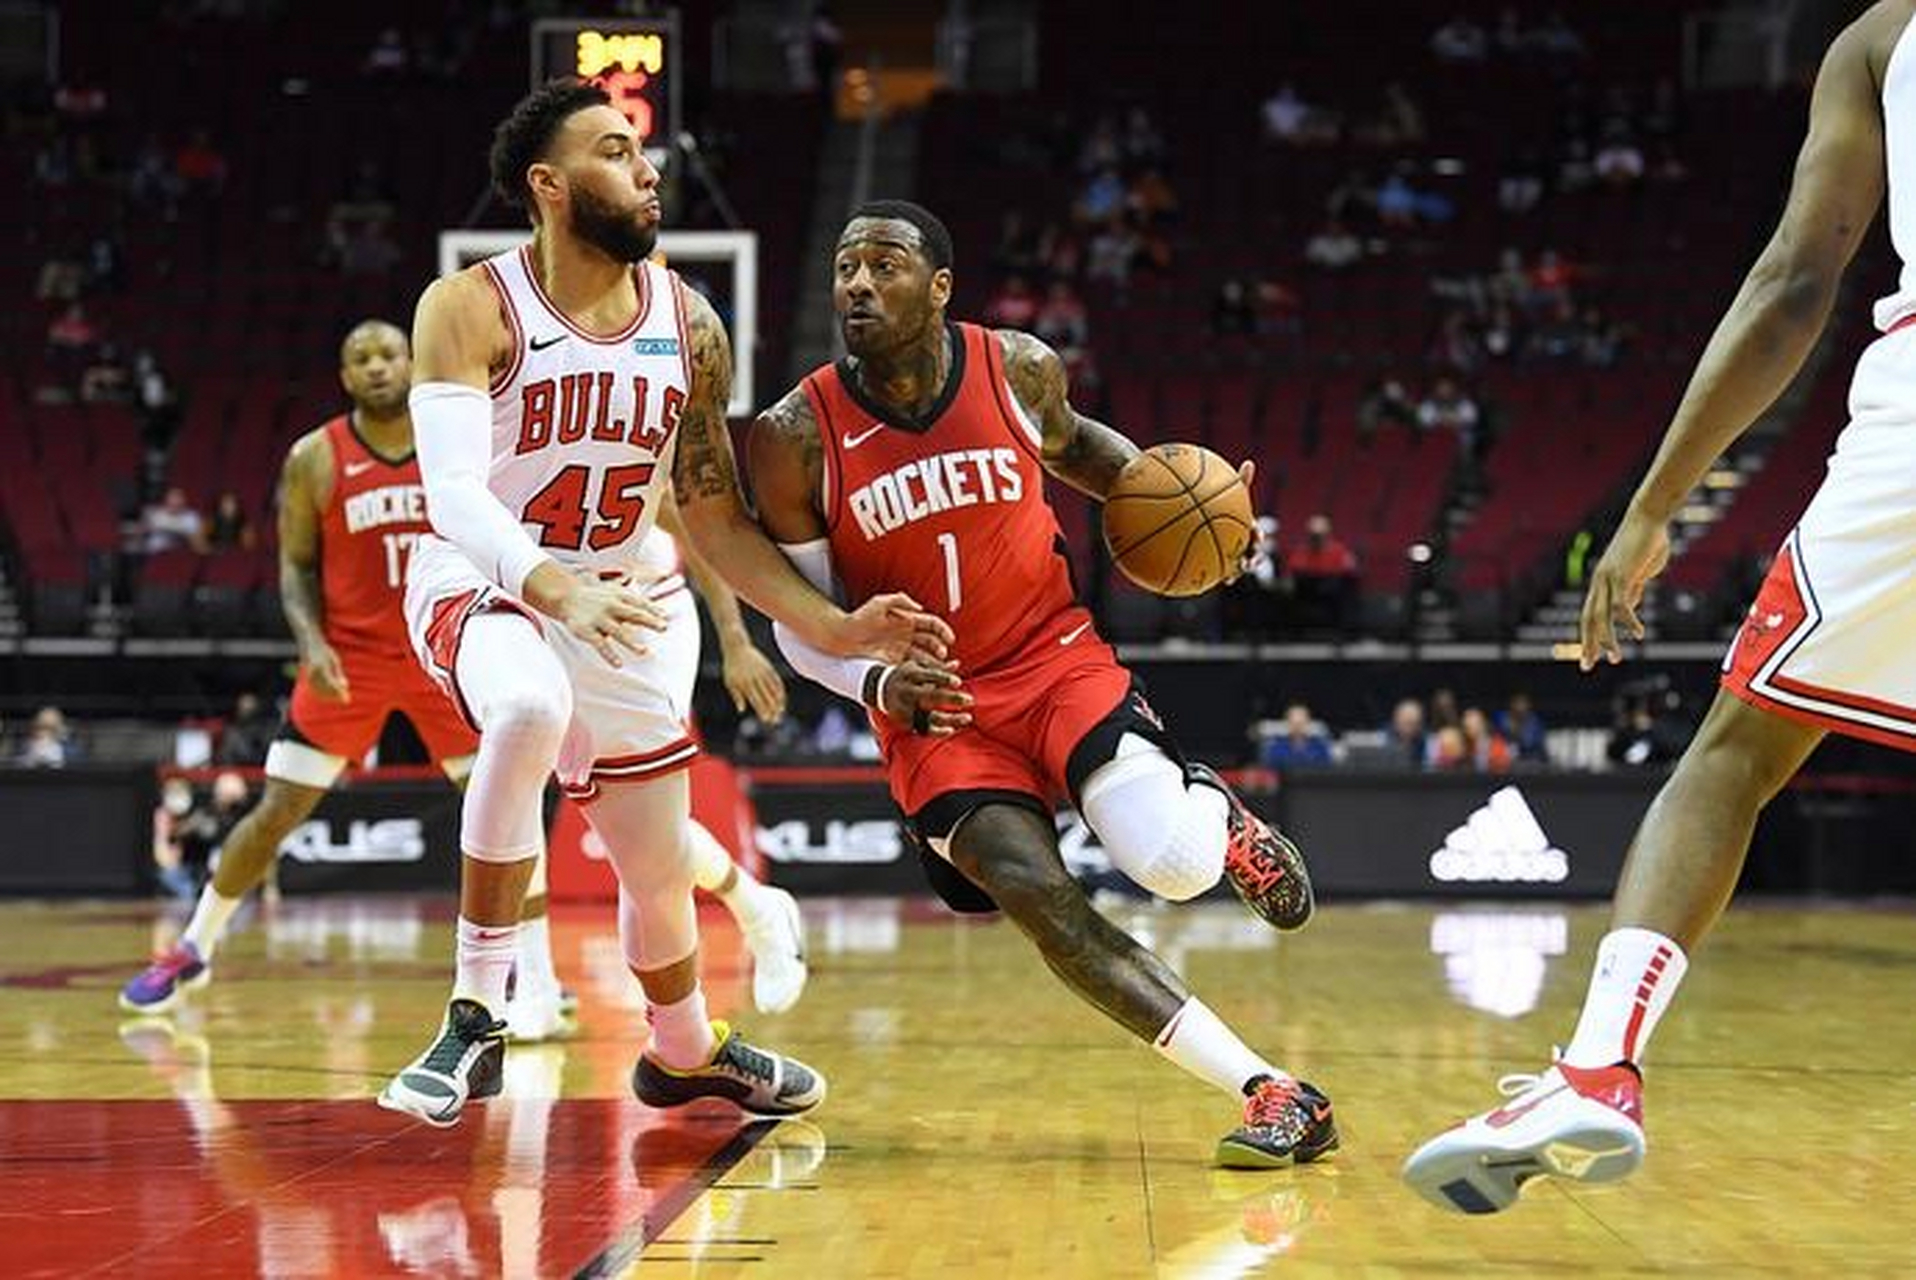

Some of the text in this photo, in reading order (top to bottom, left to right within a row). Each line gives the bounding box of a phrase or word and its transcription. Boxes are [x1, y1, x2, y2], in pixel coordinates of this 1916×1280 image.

[515, 371, 686, 459] BULLS
[345, 485, 424, 534] ROCKE
[521, 463, 655, 552] 45
[849, 447, 1022, 542] ROCKETS
[937, 532, 961, 612] 1
[278, 818, 425, 863] XUS
[756, 819, 900, 862] XUS
